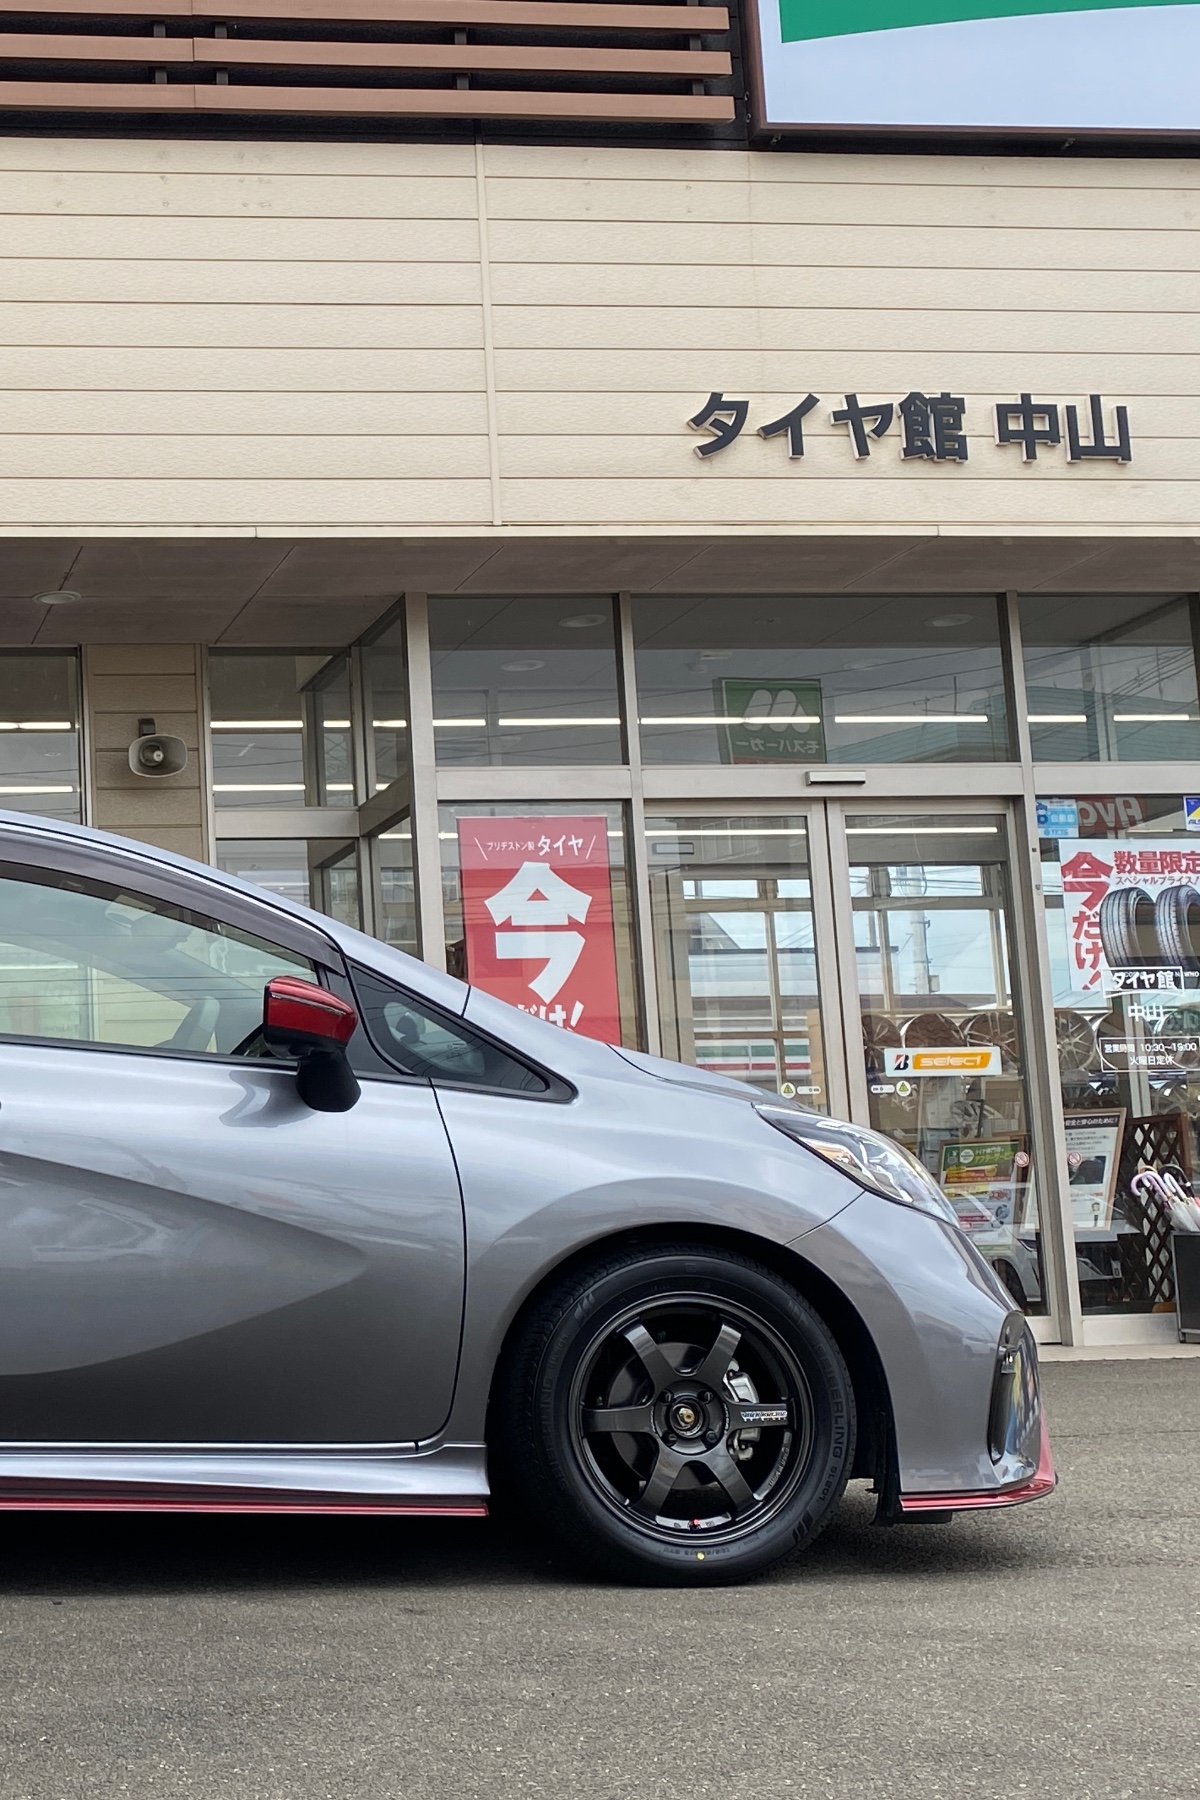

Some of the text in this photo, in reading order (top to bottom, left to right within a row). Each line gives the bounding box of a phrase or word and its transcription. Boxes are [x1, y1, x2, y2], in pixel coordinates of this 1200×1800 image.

[687, 391, 1133, 464] タイヤ館 中山
[1112, 970, 1176, 990] タイヤ館
[920, 1055, 982, 1067] select
